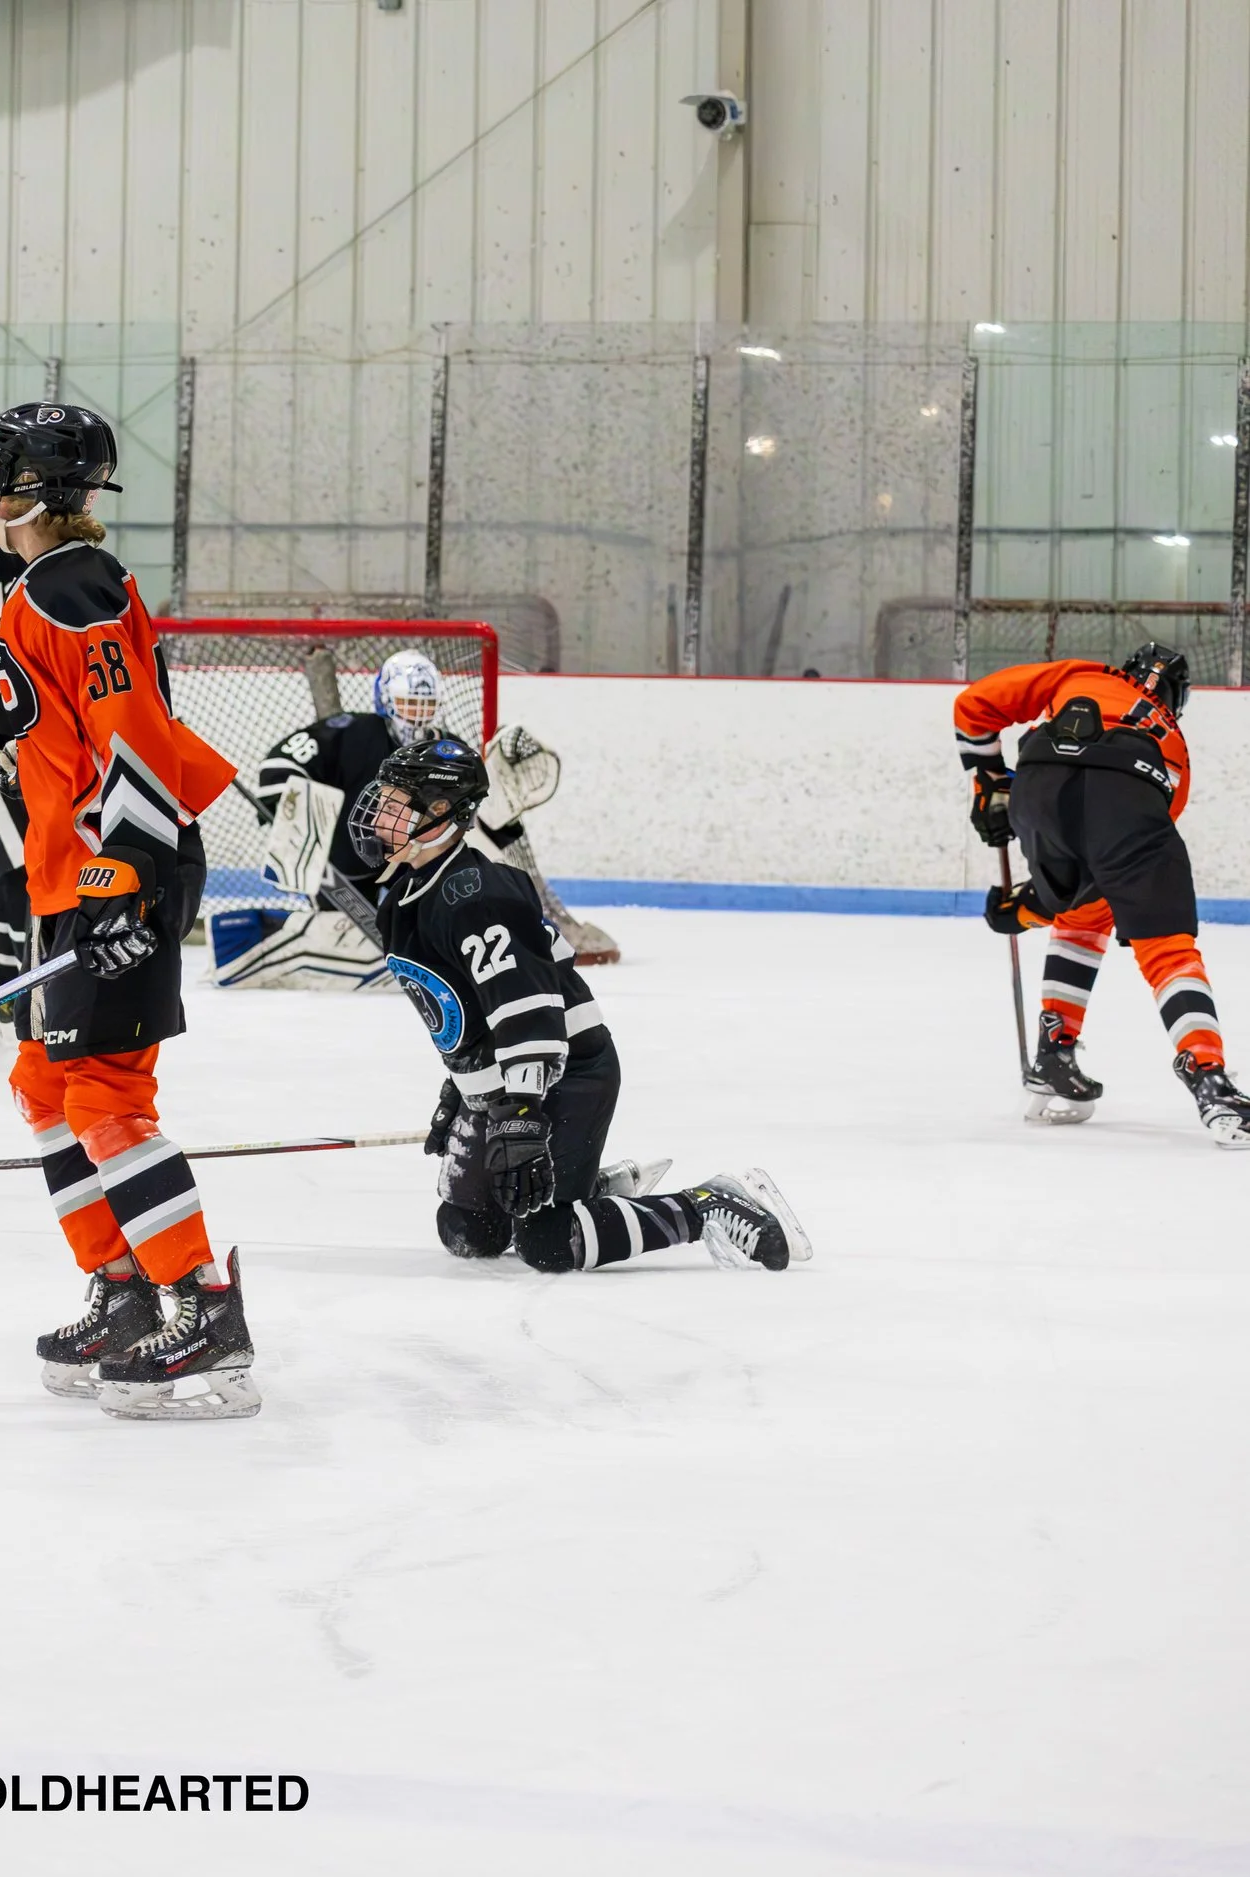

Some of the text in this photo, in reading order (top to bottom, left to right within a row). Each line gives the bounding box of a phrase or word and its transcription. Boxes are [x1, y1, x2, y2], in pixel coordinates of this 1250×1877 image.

[86, 639, 133, 702] 58
[461, 924, 518, 985] 22
[165, 1337, 209, 1365] BAUER
